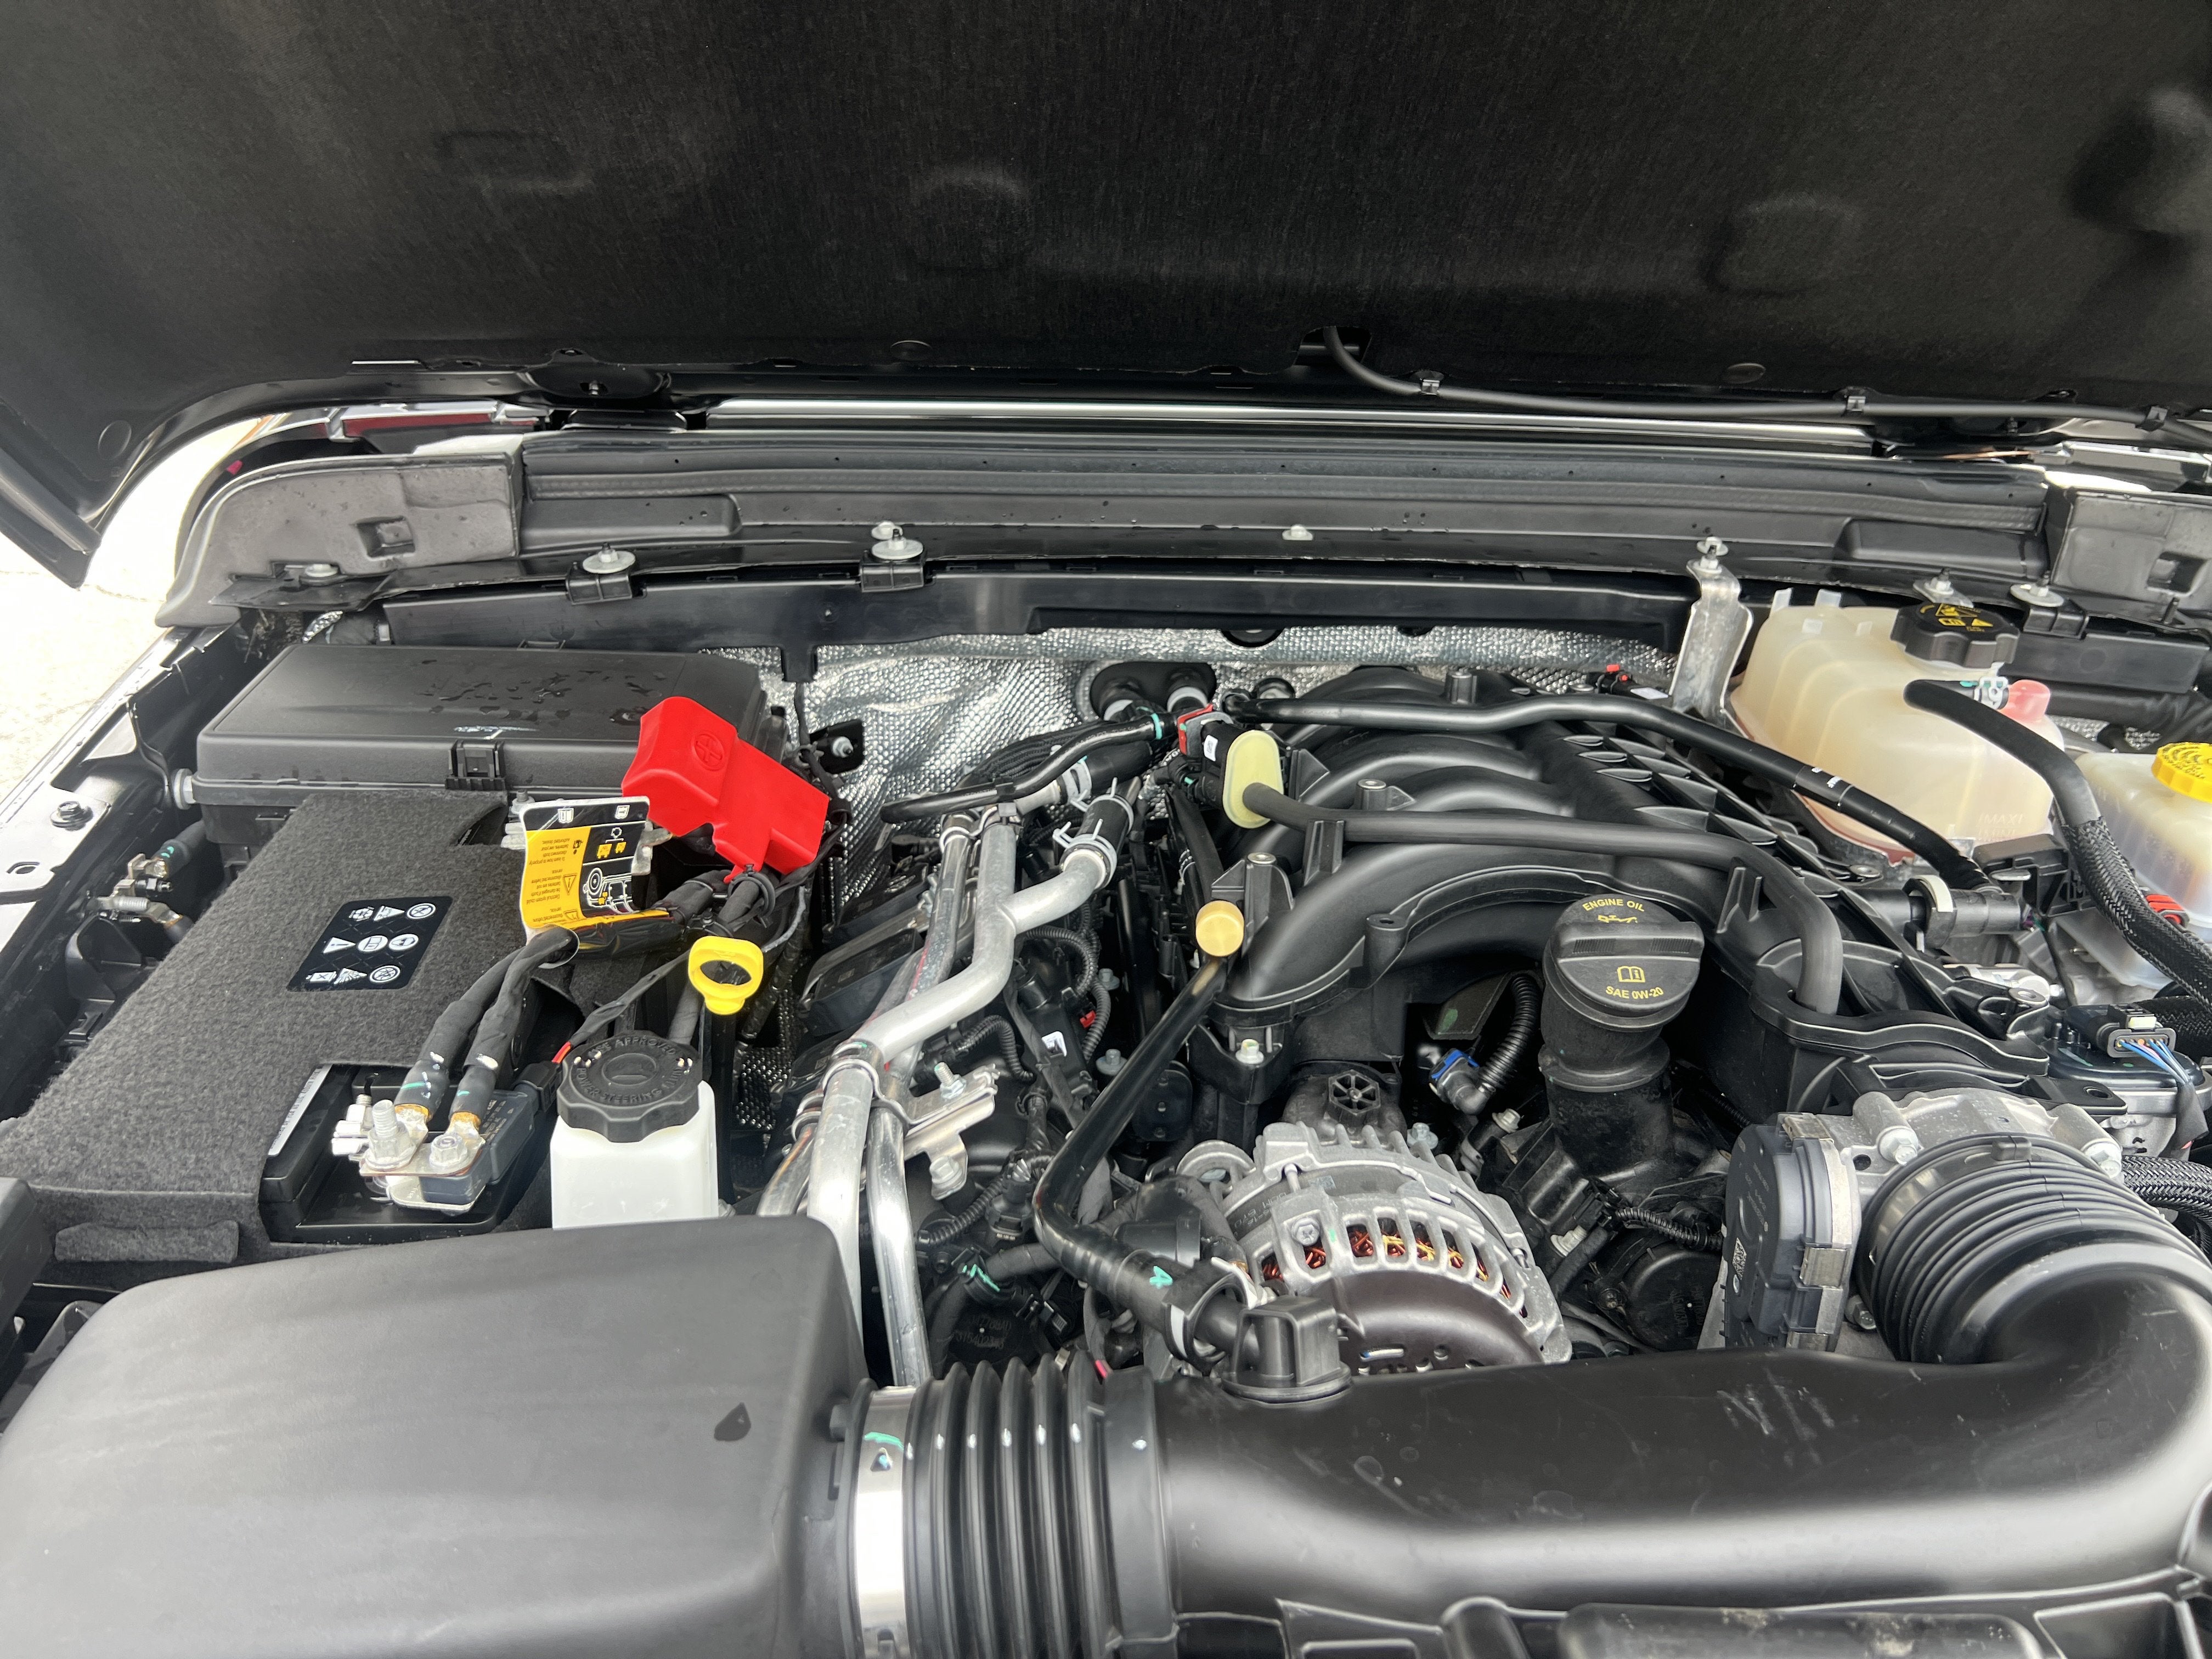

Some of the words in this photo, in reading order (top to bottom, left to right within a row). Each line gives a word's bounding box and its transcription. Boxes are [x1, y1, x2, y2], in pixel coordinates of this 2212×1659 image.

[1582, 898, 1623, 911] ENGINE
[1627, 900, 1645, 911] OIL
[1605, 985, 1629, 999] SAE
[1632, 986, 1664, 1000] 0W-20
[615, 1035, 676, 1055] APPROVED
[576, 1067, 600, 1096] POWER
[600, 1087, 662, 1104] STEERING
